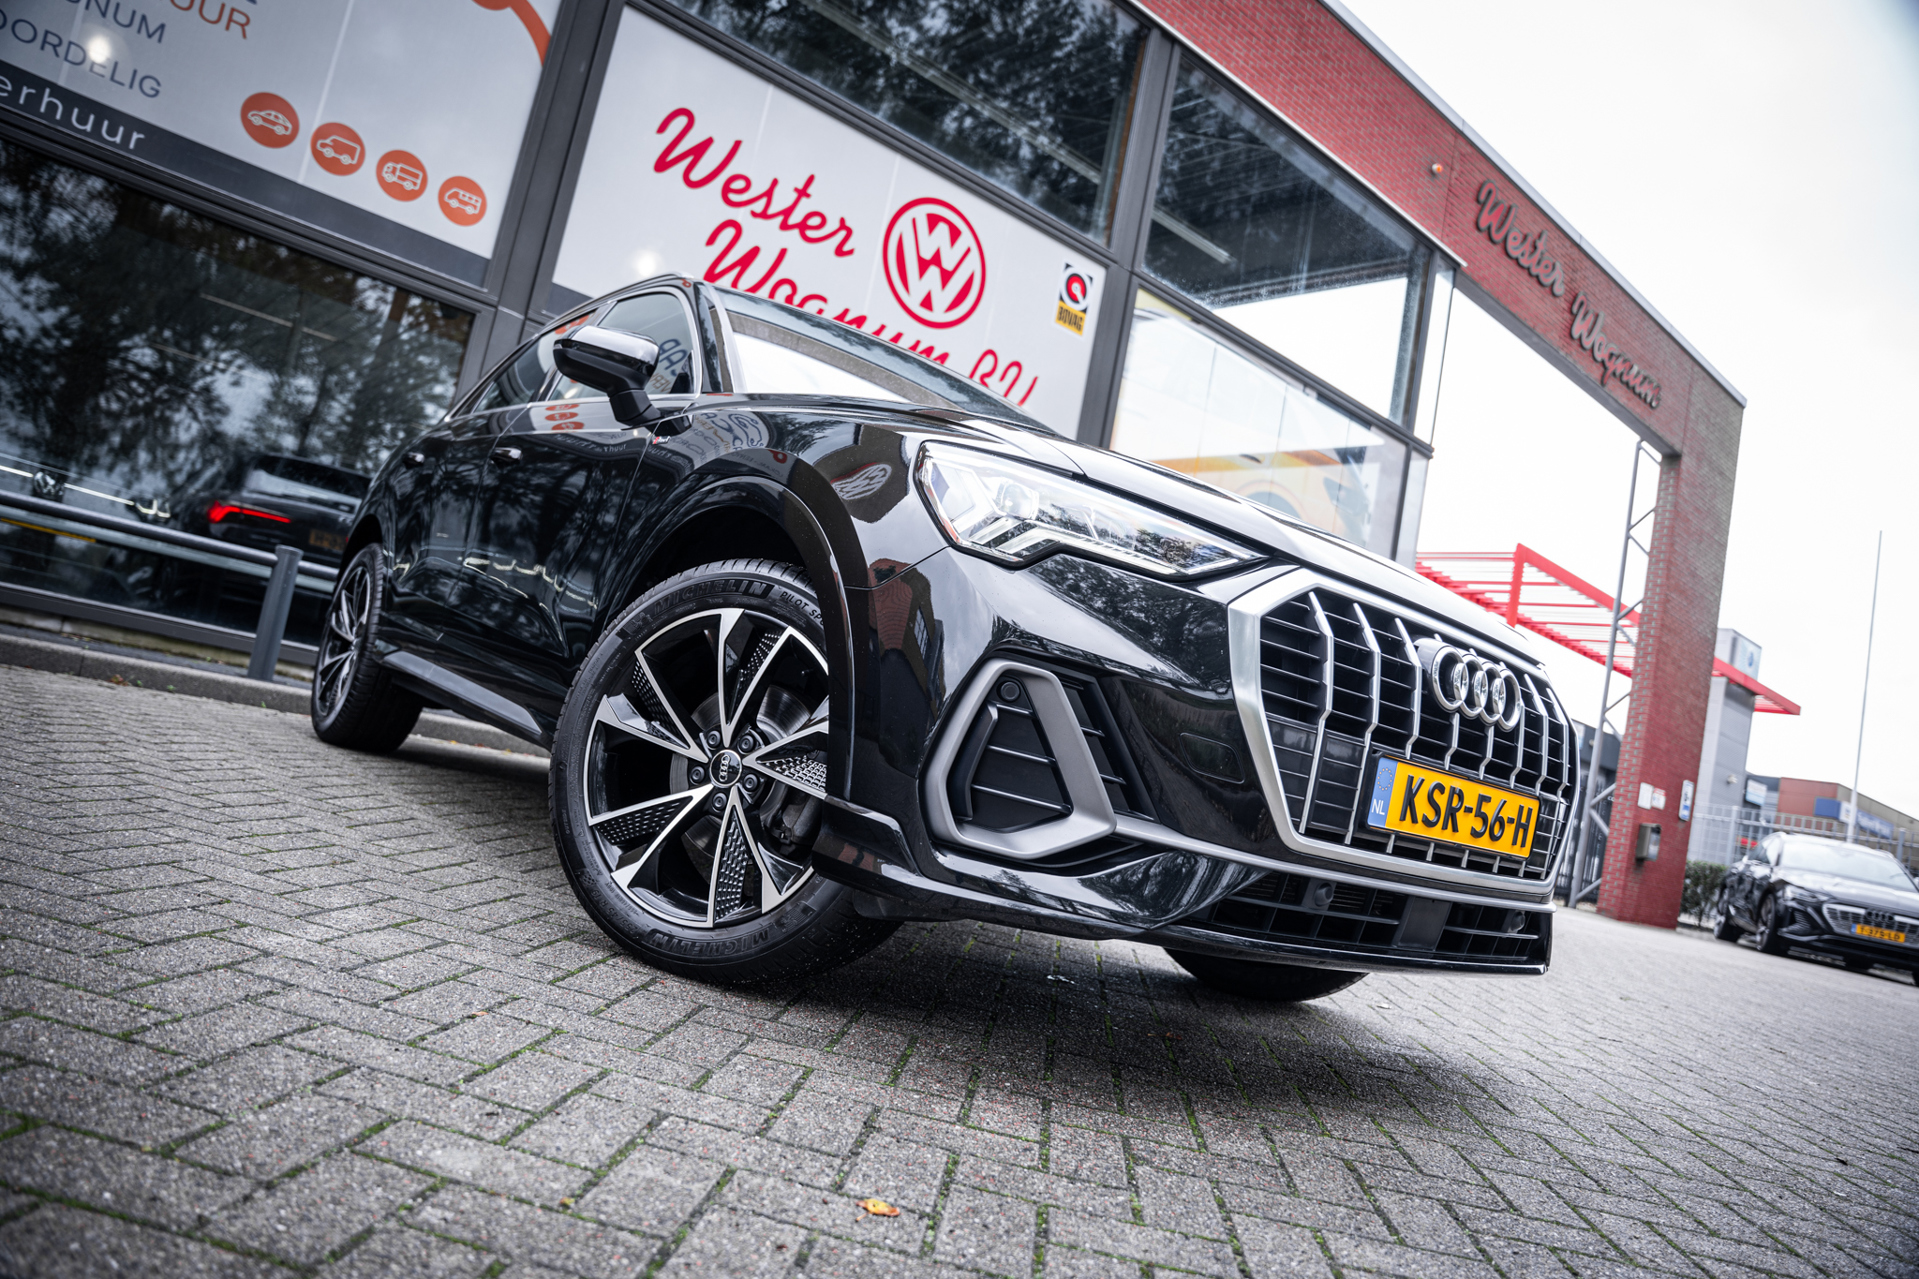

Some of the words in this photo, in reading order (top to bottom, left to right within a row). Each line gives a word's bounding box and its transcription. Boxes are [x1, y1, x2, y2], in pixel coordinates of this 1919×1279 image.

[62, 0, 166, 43] NUM
[0, 8, 162, 98] ORDELIG
[653, 107, 855, 258] Wester
[1476, 179, 1565, 297] Wester
[654, 579, 764, 613] MICHELIN
[780, 591, 808, 609] PILOT
[1371, 798, 1386, 816] NL
[1399, 774, 1533, 848] KSR-56-H
[652, 928, 769, 955] MICHELIN
